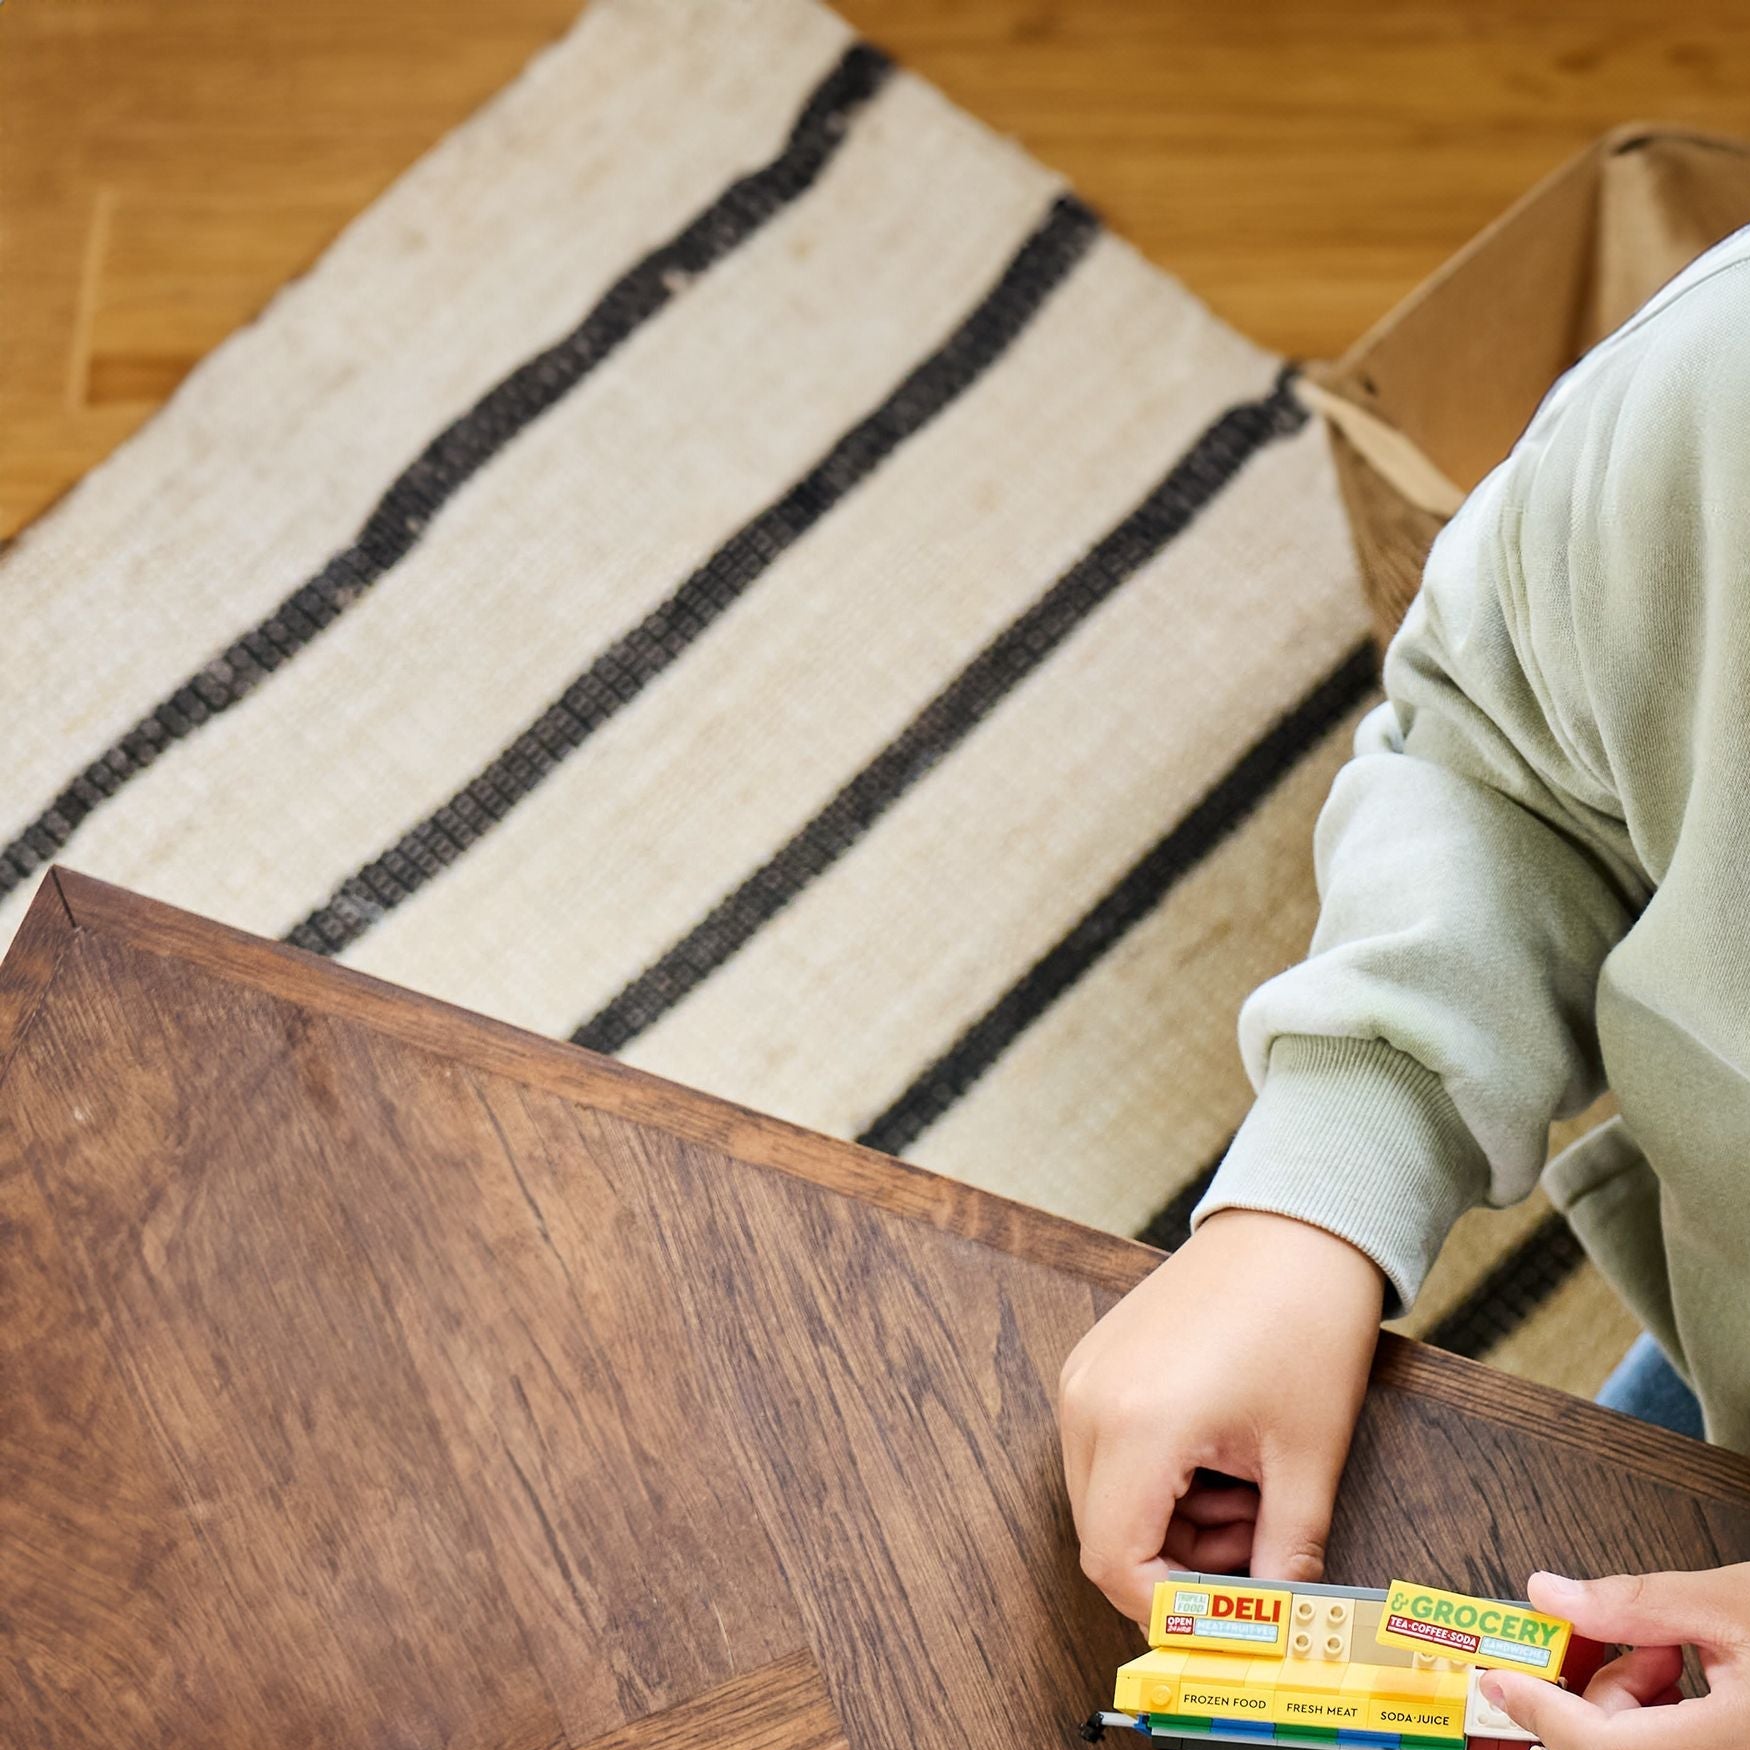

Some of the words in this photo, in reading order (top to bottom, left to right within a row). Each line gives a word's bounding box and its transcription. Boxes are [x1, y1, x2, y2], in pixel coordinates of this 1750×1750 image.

[1211, 1594, 1282, 1623] DELI
[1167, 1616, 1193, 1626] OPEN
[1391, 1592, 1409, 1612] &
[1411, 1596, 1561, 1646] GROCERY
[1183, 1694, 1230, 1706] FROZEN
[1233, 1697, 1267, 1709] FOOD
[1286, 1702, 1324, 1715] FRESH
[1326, 1706, 1358, 1717] MEAT
